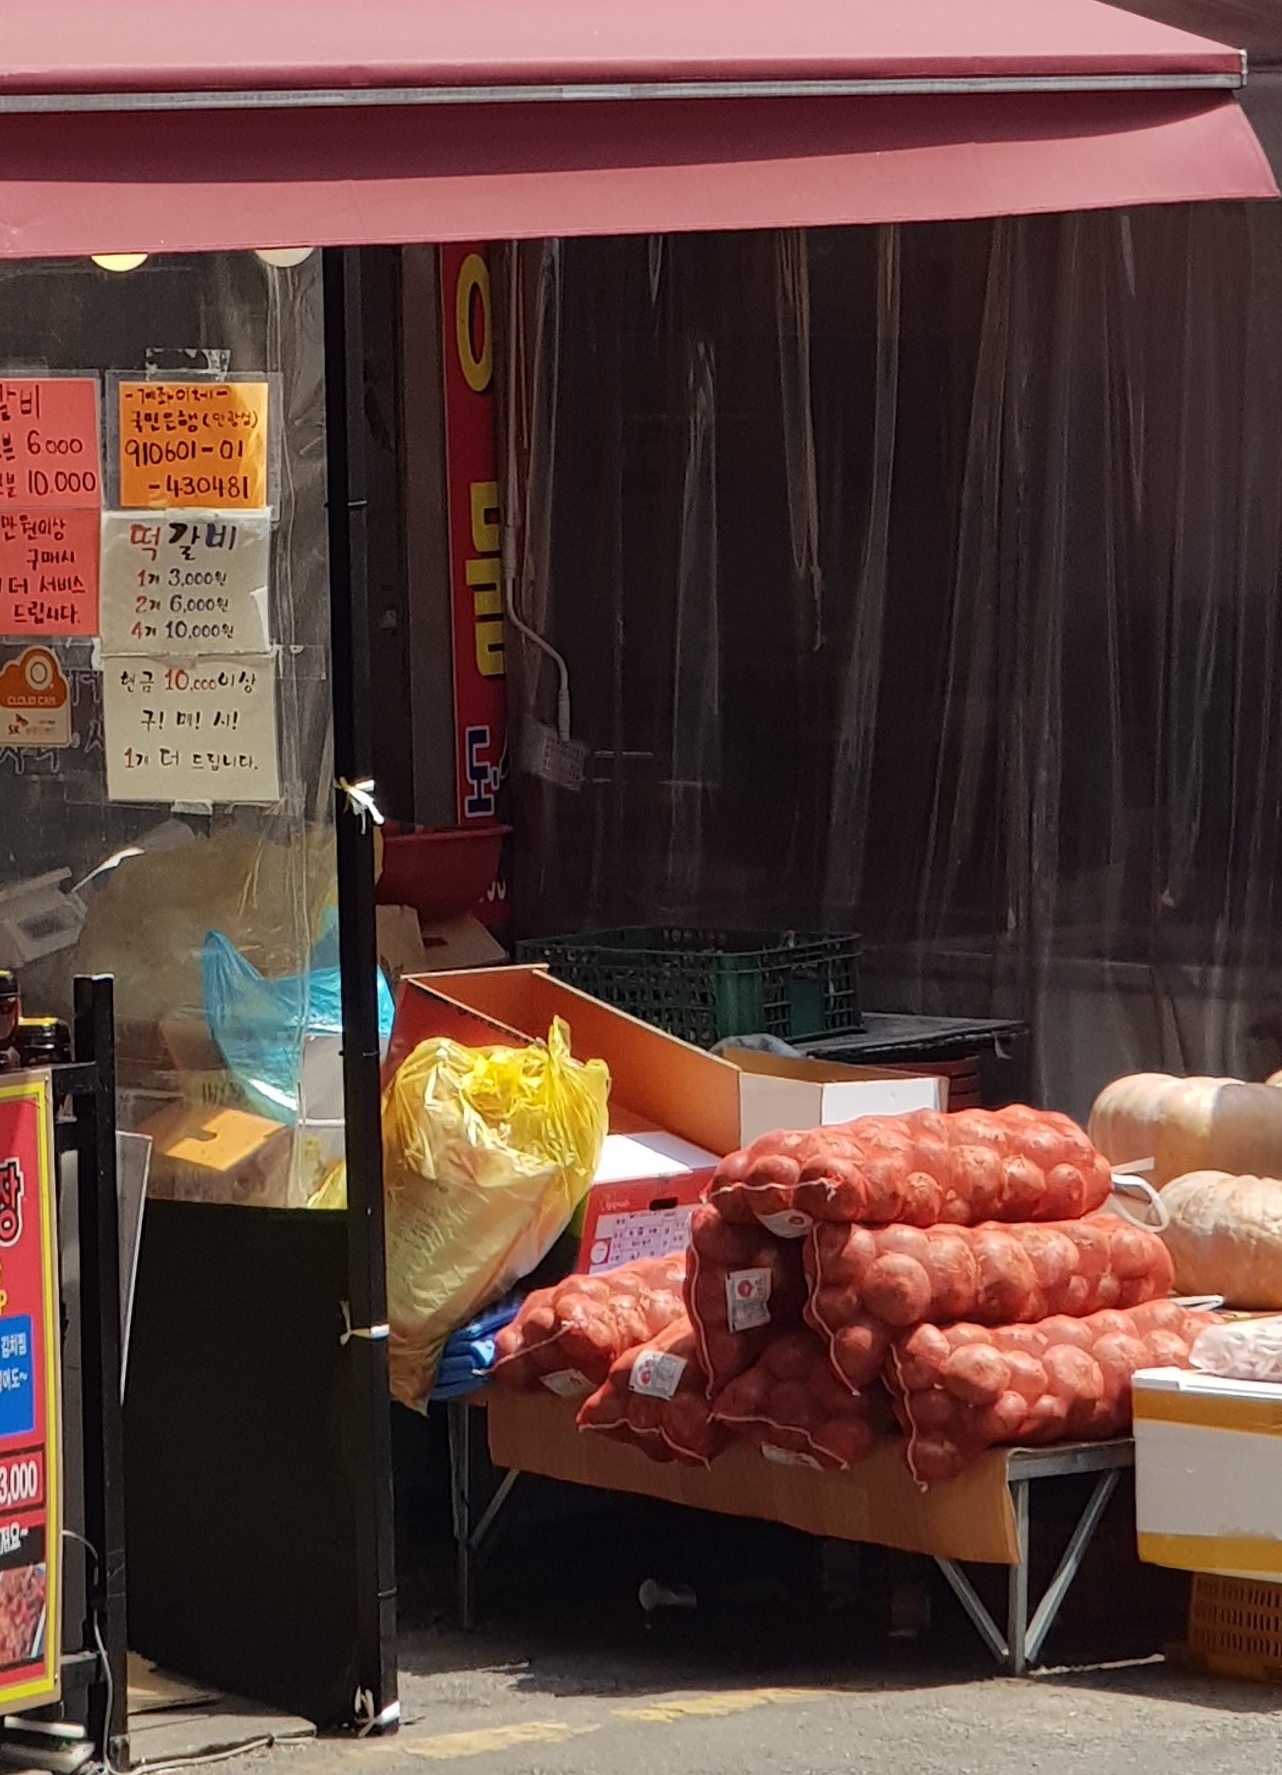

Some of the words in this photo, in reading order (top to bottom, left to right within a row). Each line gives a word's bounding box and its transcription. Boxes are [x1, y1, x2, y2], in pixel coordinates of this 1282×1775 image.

[130, 410, 199, 433] 국민은행
[8, 577, 29, 594] 더
[39, 575, 87, 594] 서비스
[120, 670, 156, 693] 현금
[159, 748, 180, 766] 더
